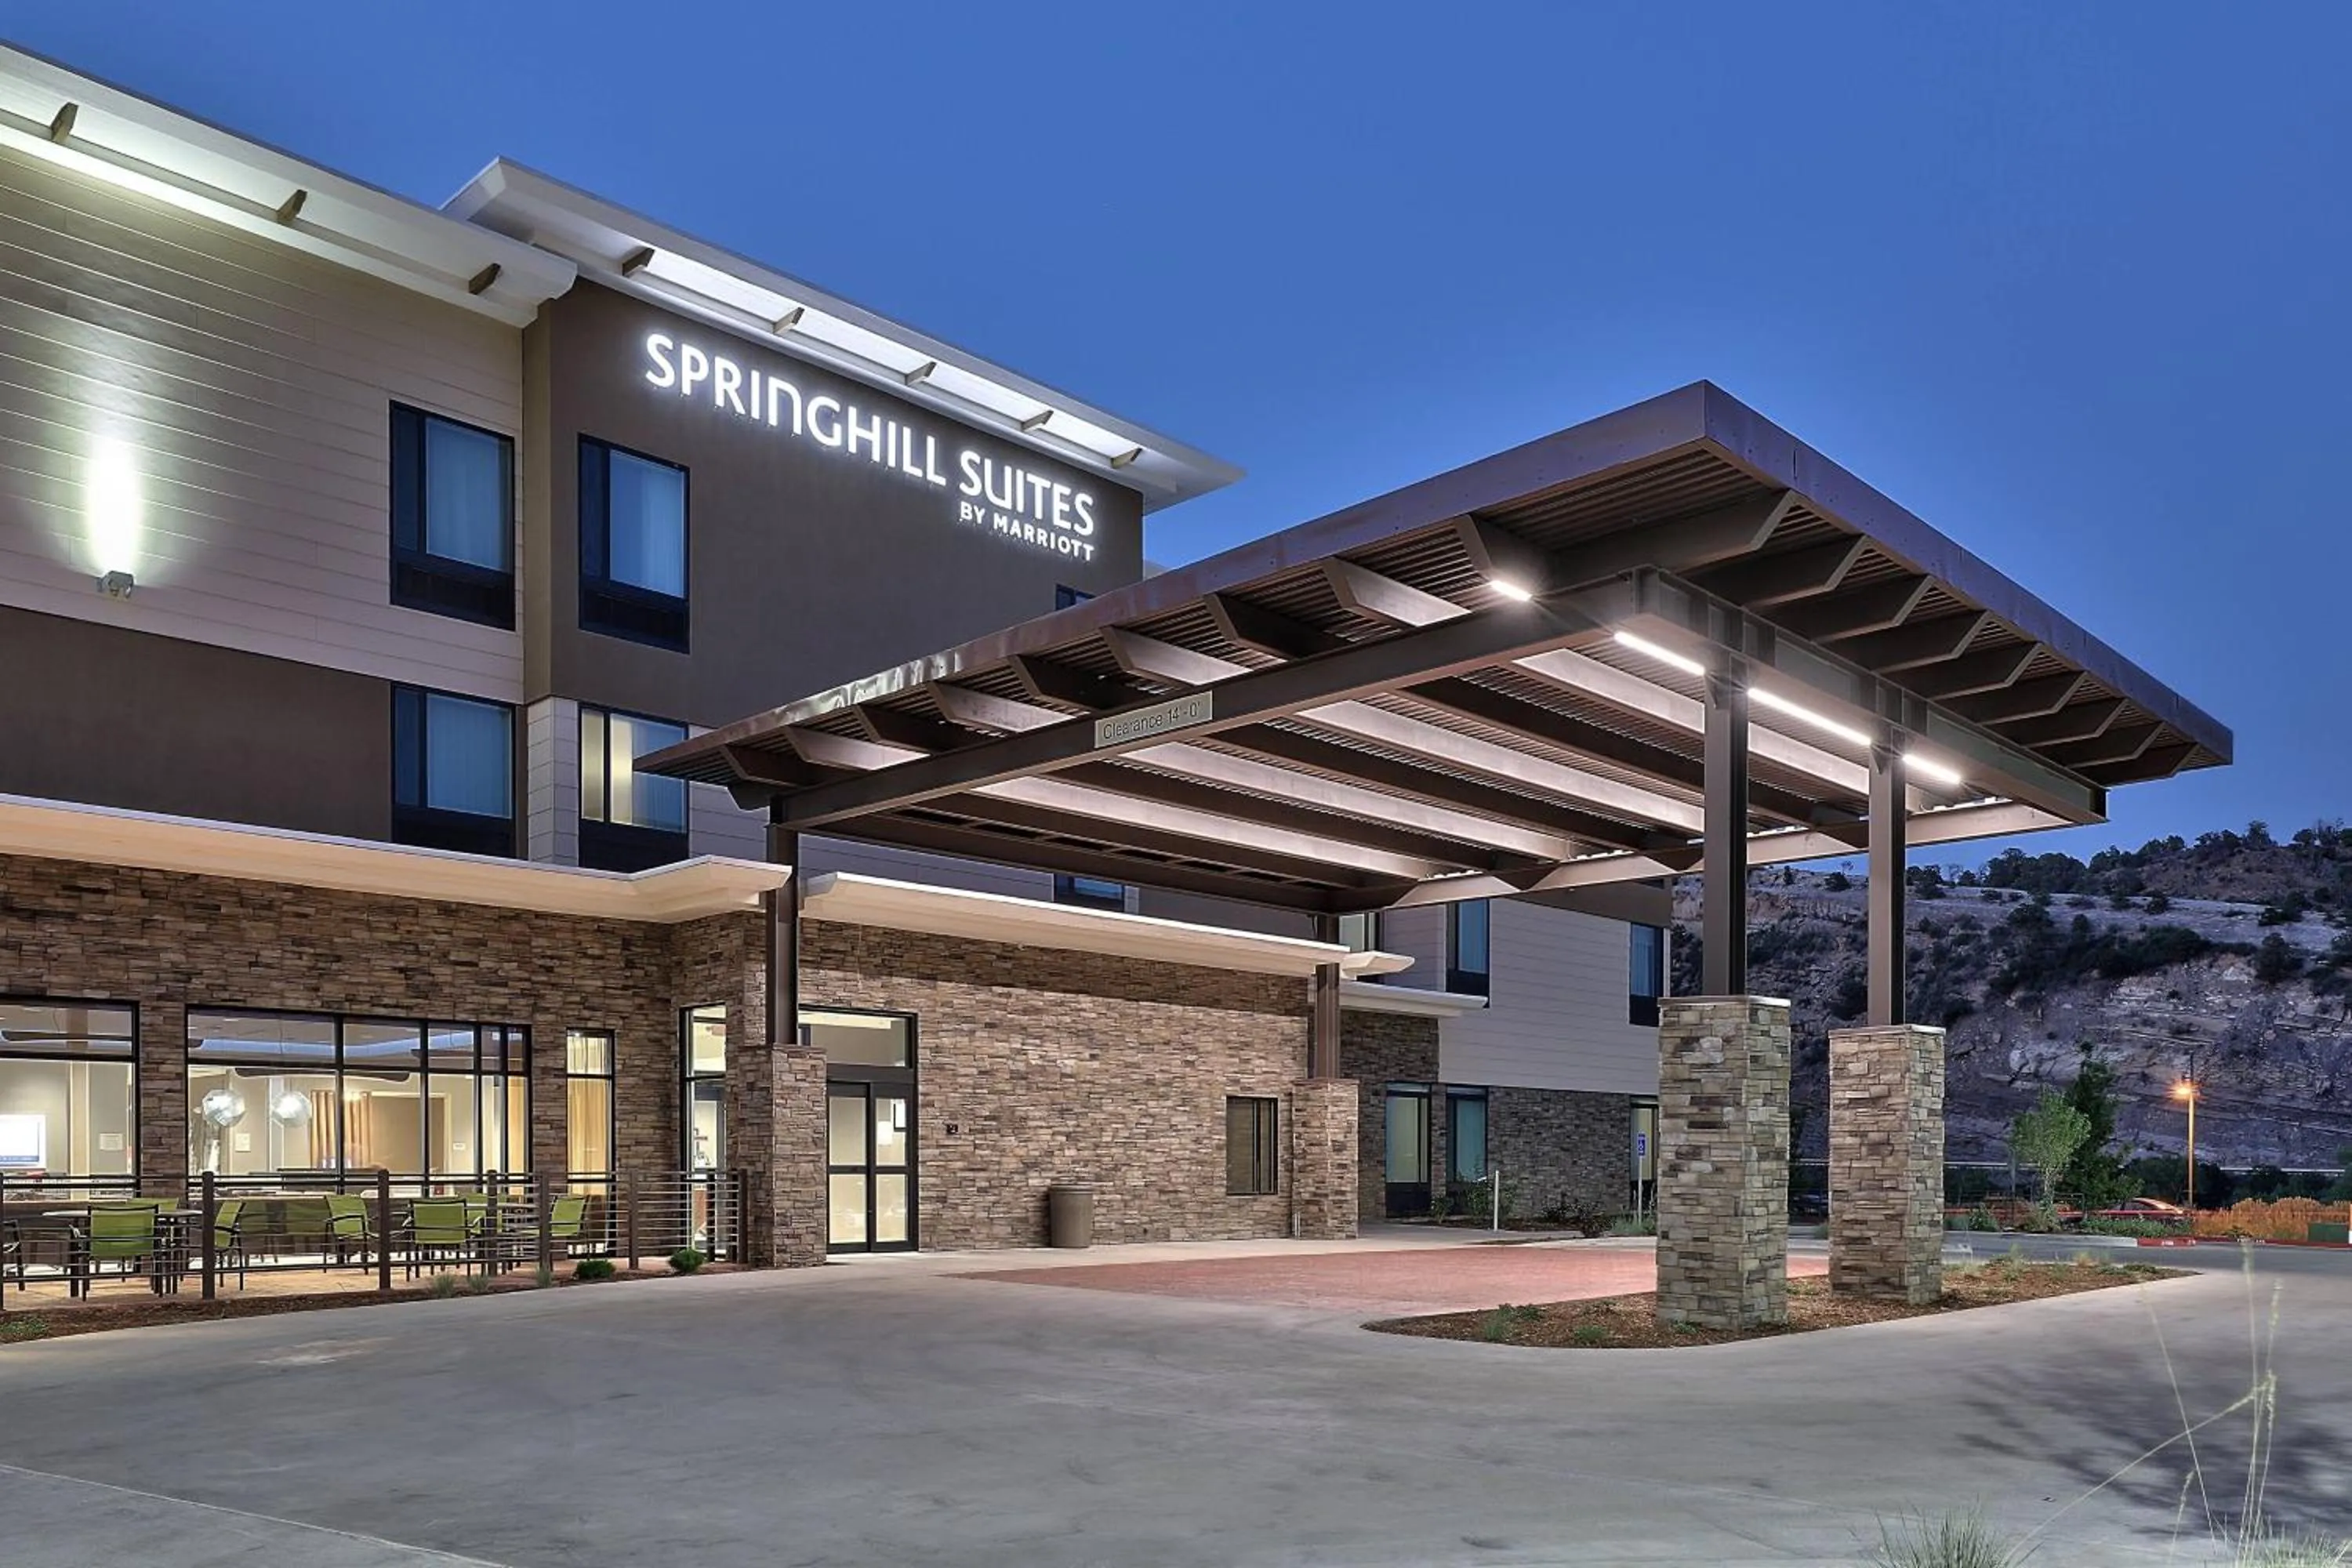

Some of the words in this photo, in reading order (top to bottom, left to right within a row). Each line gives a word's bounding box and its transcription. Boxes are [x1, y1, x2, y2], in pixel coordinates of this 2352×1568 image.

[645, 333, 946, 486] SPRINGHILL
[959, 450, 1094, 536] SUITES
[960, 501, 985, 524] BY
[993, 512, 1095, 561] MARRIOTT
[1103, 714, 1163, 739] Clearance
